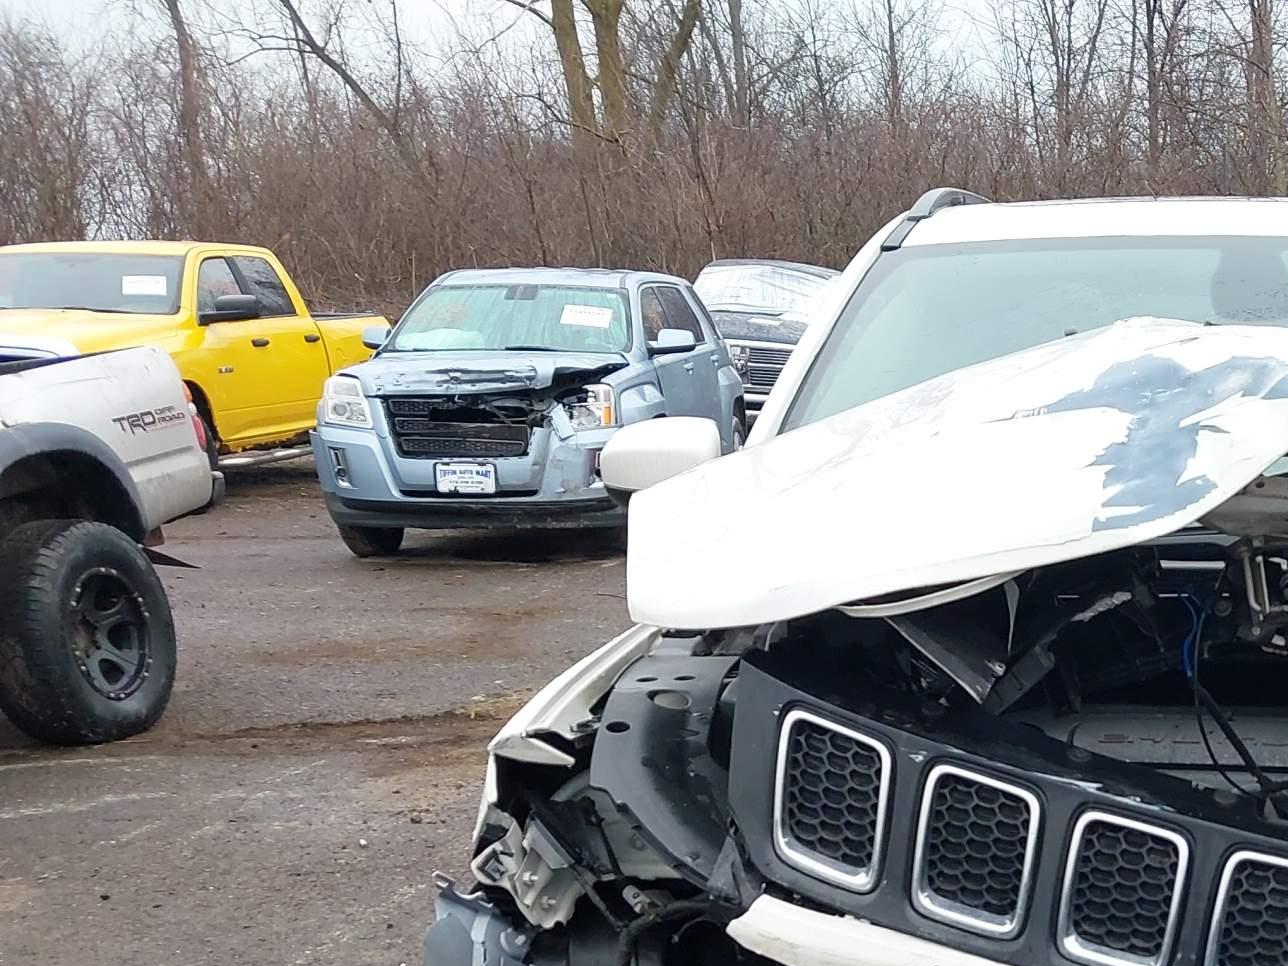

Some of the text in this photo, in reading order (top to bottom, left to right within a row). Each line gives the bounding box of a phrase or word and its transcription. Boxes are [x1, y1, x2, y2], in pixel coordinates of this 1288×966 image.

[153, 405, 176, 416] OFF
[111, 410, 157, 435] TRD
[157, 411, 186, 424] ROAD
